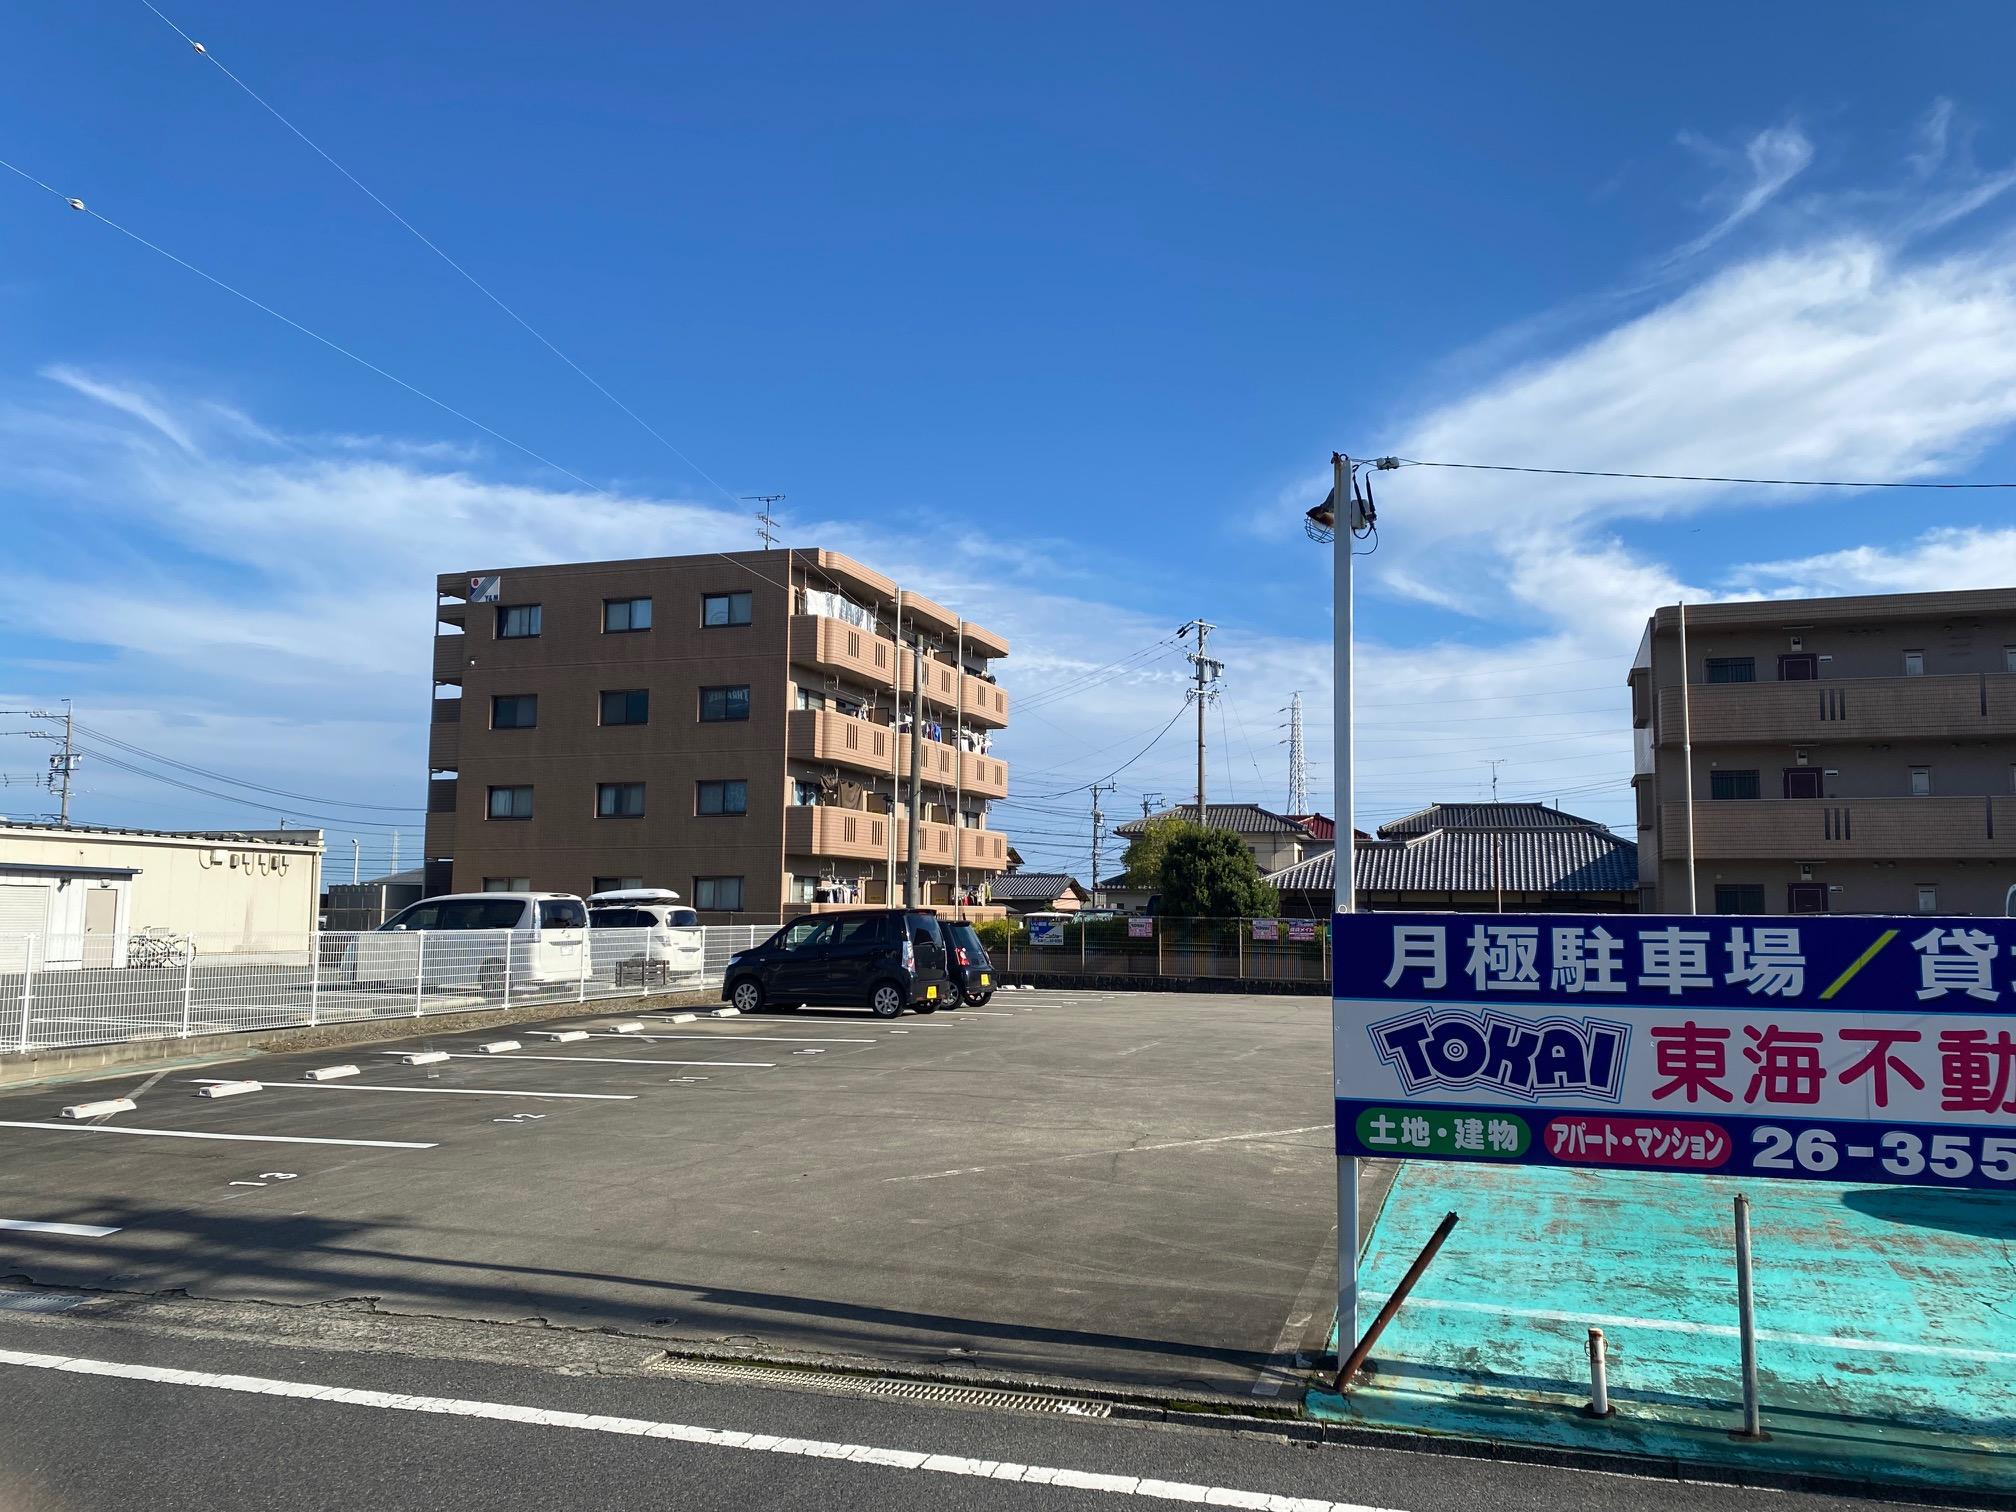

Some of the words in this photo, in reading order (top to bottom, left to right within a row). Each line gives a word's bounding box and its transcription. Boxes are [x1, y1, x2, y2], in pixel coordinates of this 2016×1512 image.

[1374, 1013, 1626, 1097] TOKAI
[228, 1172, 298, 1187] 13
[1367, 1113, 1519, 1152] 土地・建物
[1550, 1121, 1724, 1162] アパート・マンション
[1751, 1125, 2016, 1183] 26-355
